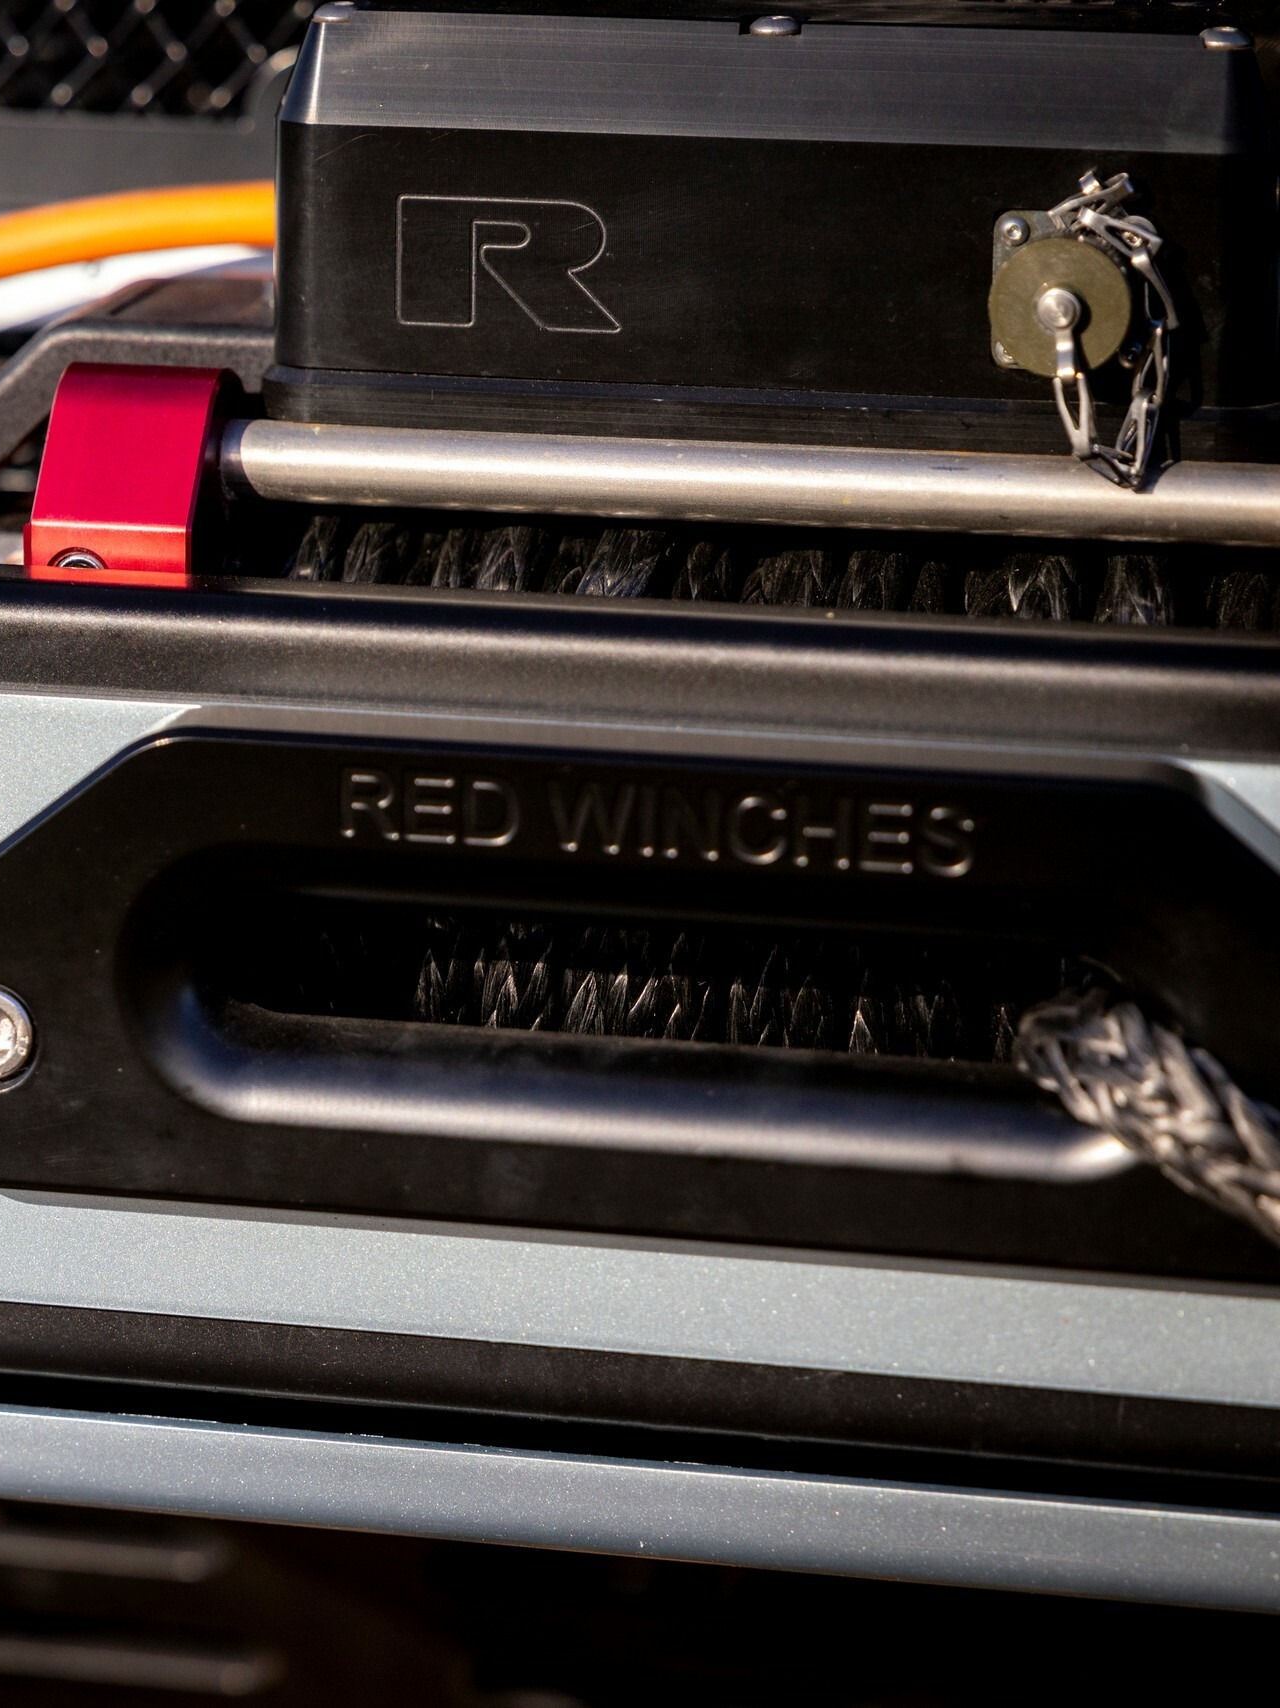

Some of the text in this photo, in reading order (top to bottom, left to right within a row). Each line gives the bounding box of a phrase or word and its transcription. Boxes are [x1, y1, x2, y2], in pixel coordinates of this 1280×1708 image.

[395, 193, 621, 333] R
[340, 766, 975, 878] RED WINCHES
